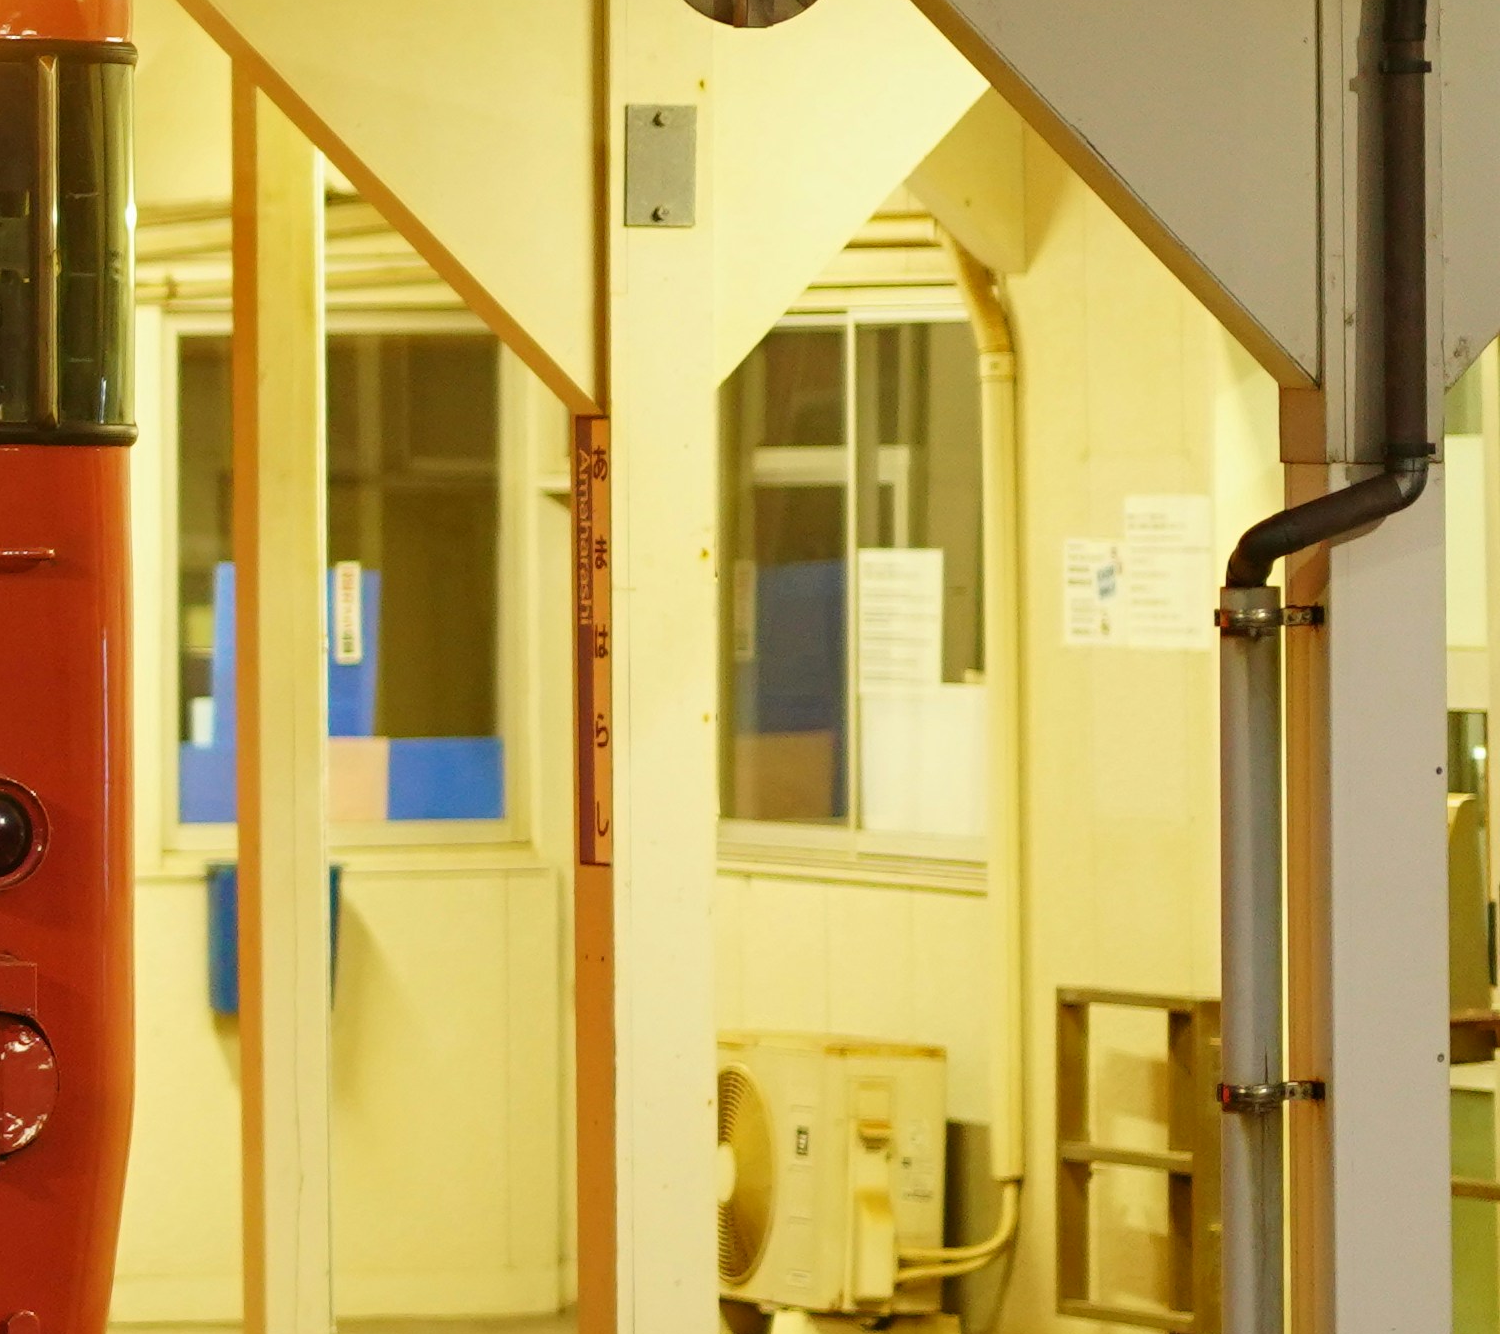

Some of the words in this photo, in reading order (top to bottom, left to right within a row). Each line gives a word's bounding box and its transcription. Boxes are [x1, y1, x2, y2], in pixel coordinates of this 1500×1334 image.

[578, 449, 592, 625] Amaharashi
[592, 444, 610, 837] あまはらし
